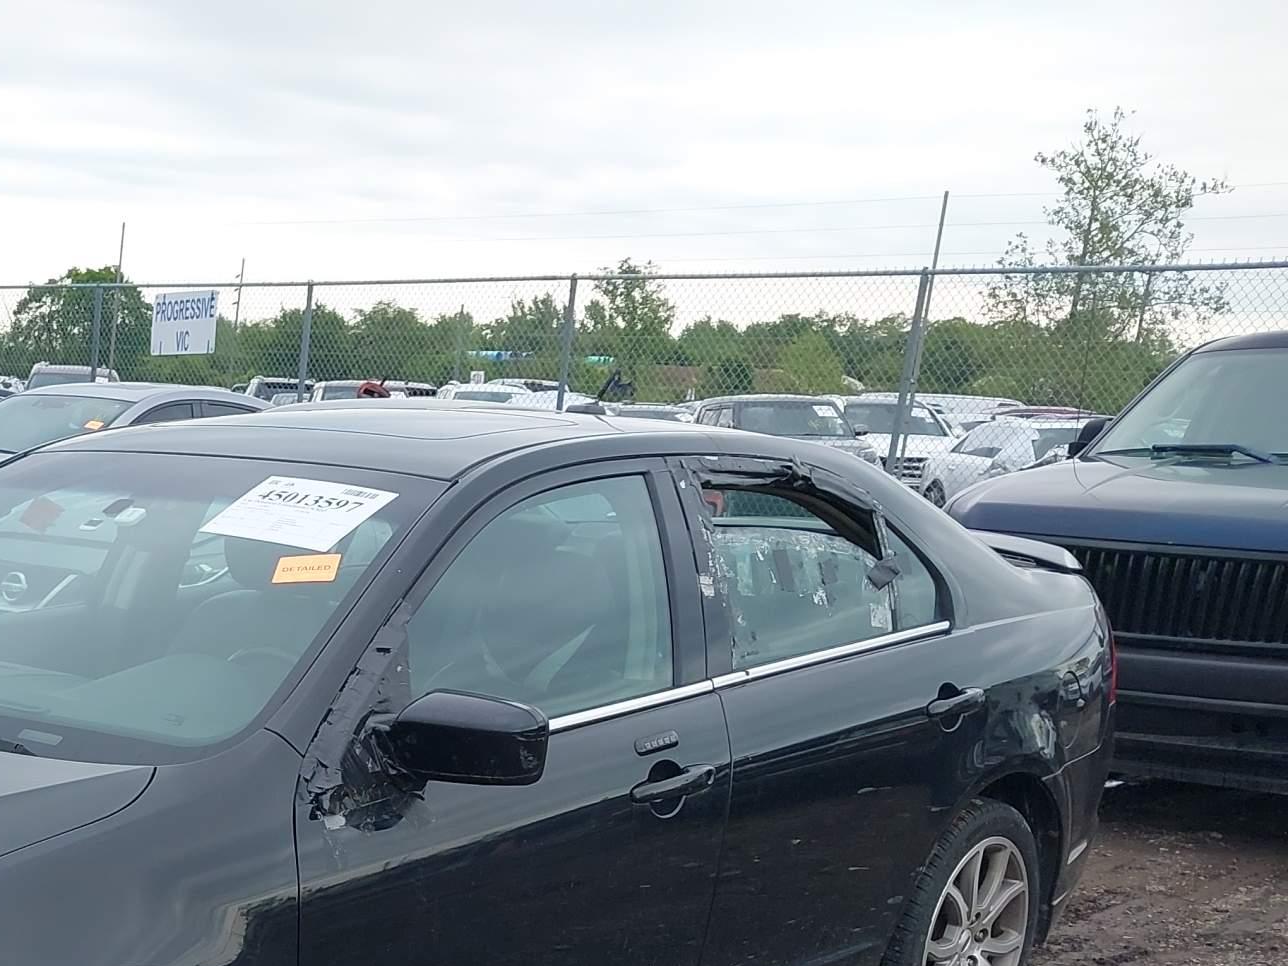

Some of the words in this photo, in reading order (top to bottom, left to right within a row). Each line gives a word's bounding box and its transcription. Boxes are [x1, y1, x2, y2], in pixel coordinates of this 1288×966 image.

[155, 297, 215, 322] PROGRESSIVE
[176, 330, 190, 352] VIC
[257, 489, 365, 513] 45013597
[281, 564, 332, 574] DETAILED
